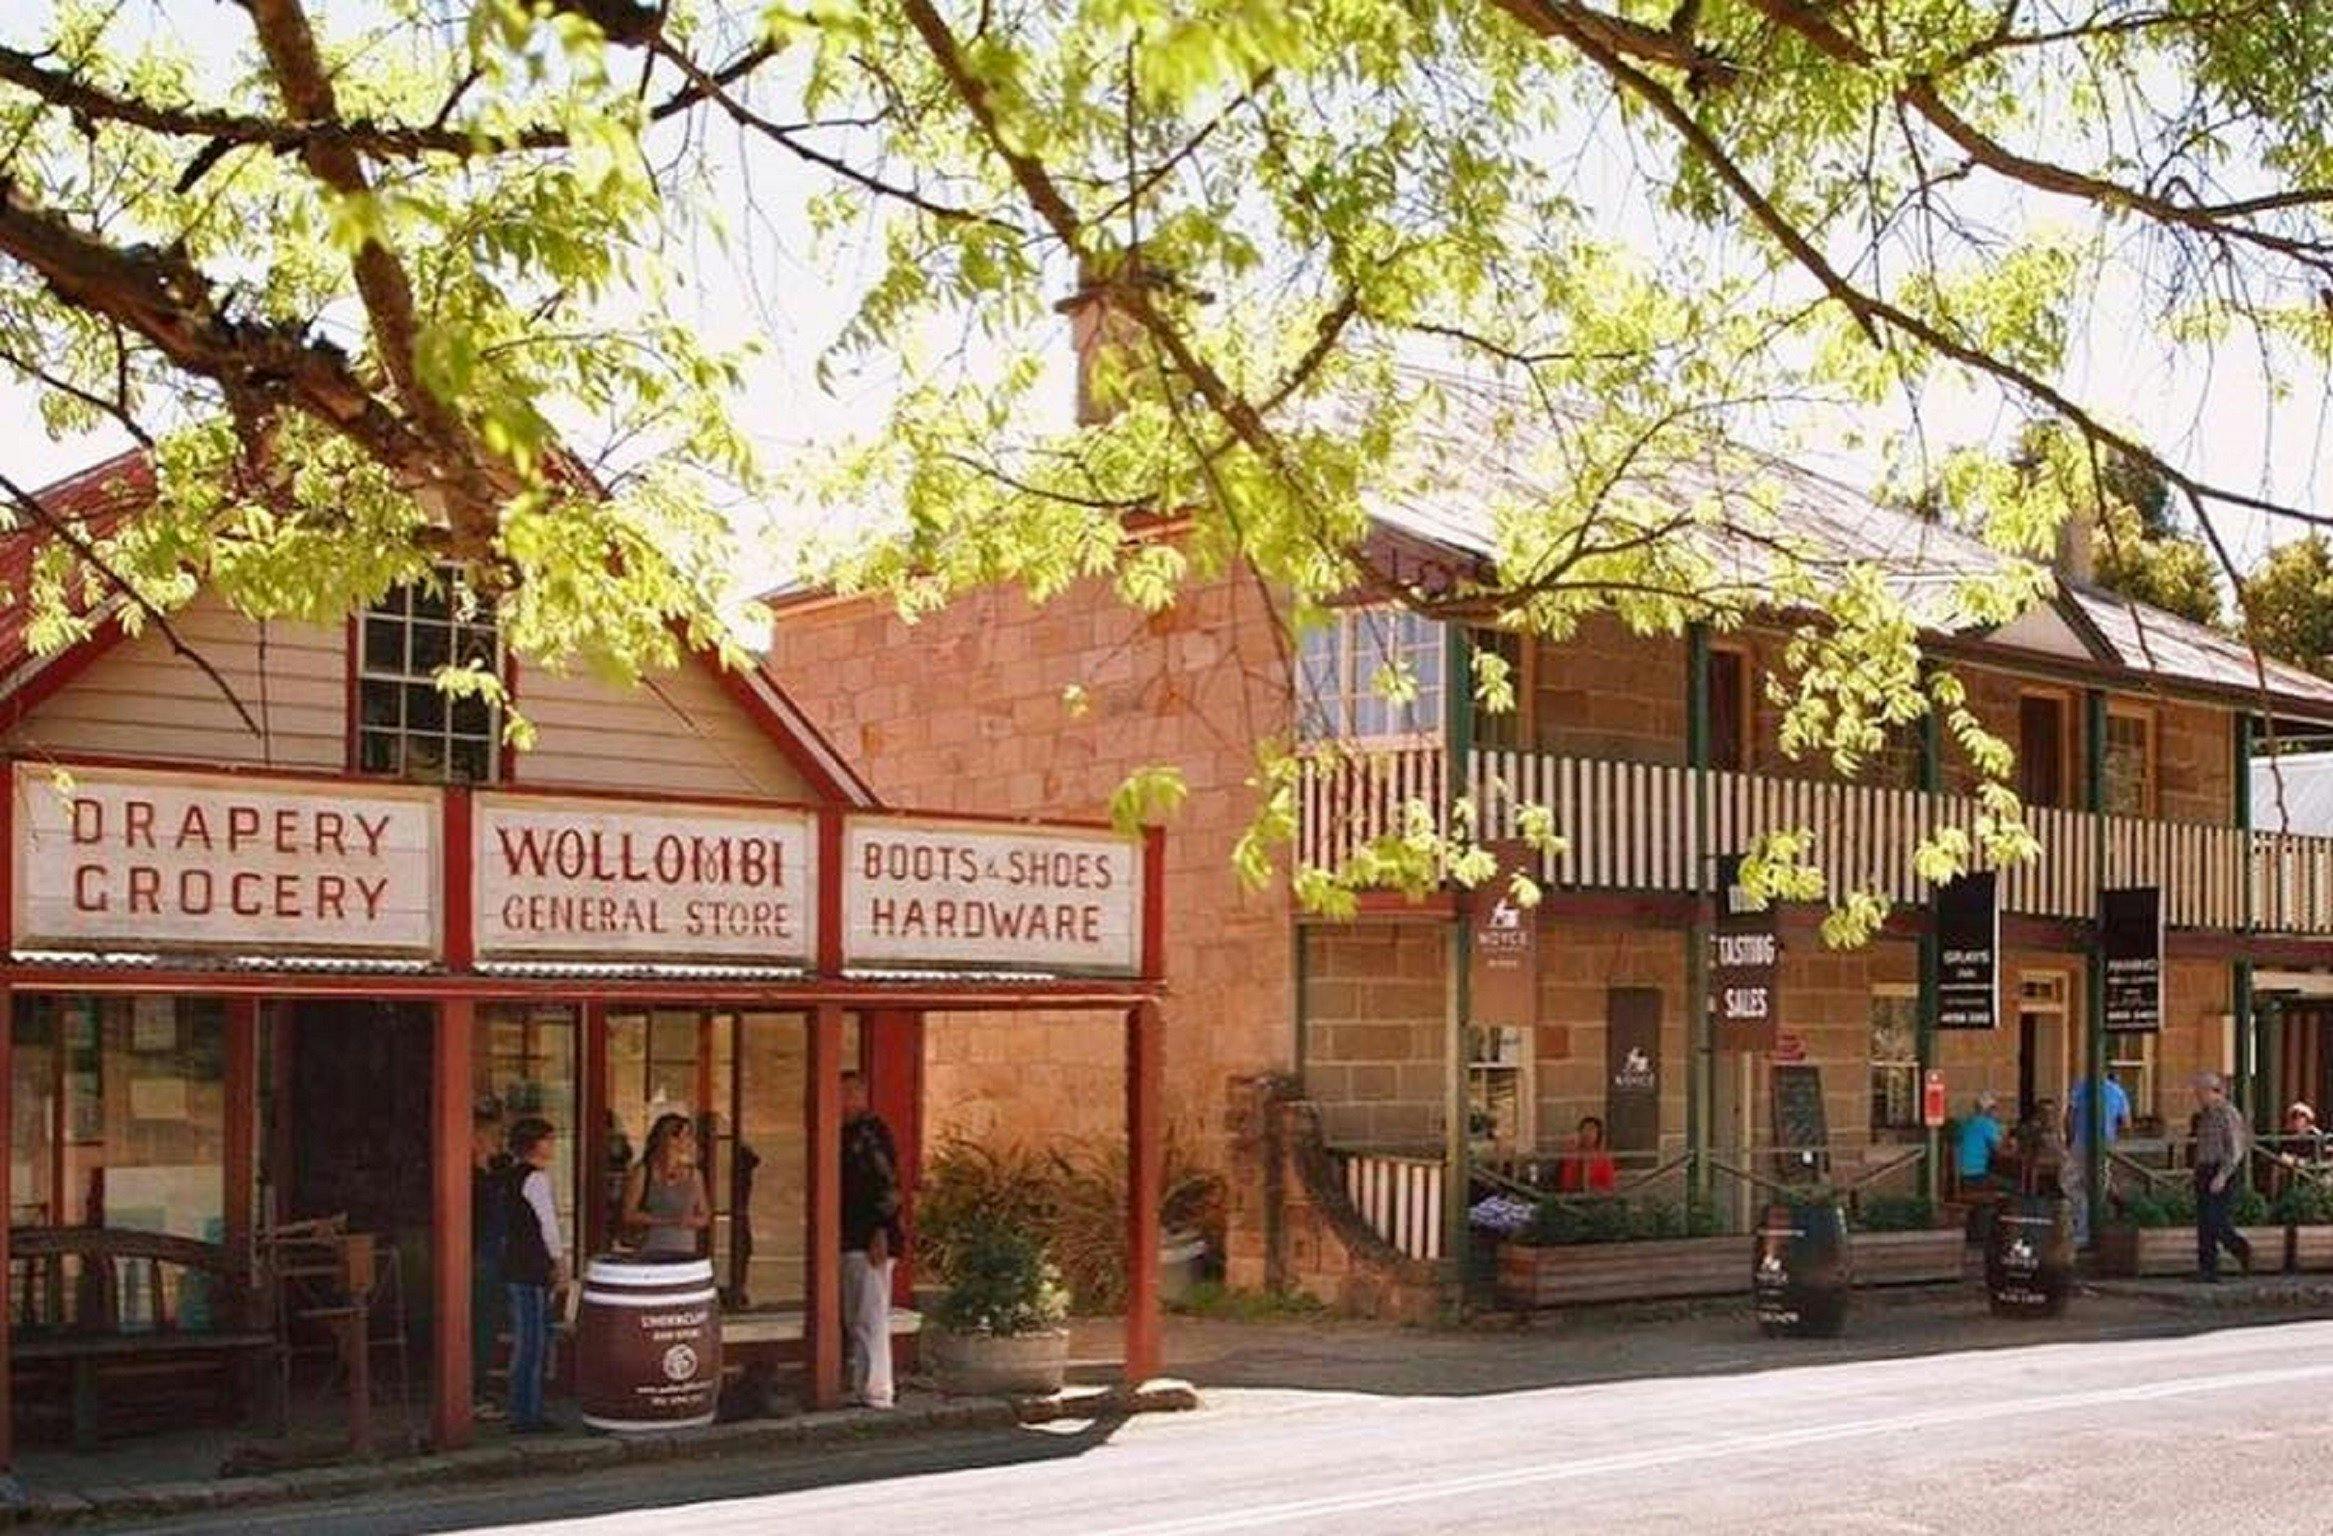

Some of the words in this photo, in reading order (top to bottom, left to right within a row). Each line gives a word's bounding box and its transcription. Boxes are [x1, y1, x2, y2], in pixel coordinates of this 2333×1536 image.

[70, 797, 391, 858] DRAPERY
[496, 826, 784, 889] WOLLOMBI
[863, 841, 979, 884] BOOTS
[1006, 849, 1112, 891] SHOES
[73, 863, 389, 922] GROCERY
[501, 893, 669, 936] GENERAL
[685, 899, 793, 940] STORE
[872, 896, 1101, 943] HARDWARE
[1718, 933, 1776, 966] TASTING
[1724, 987, 1768, 1018] SALES
